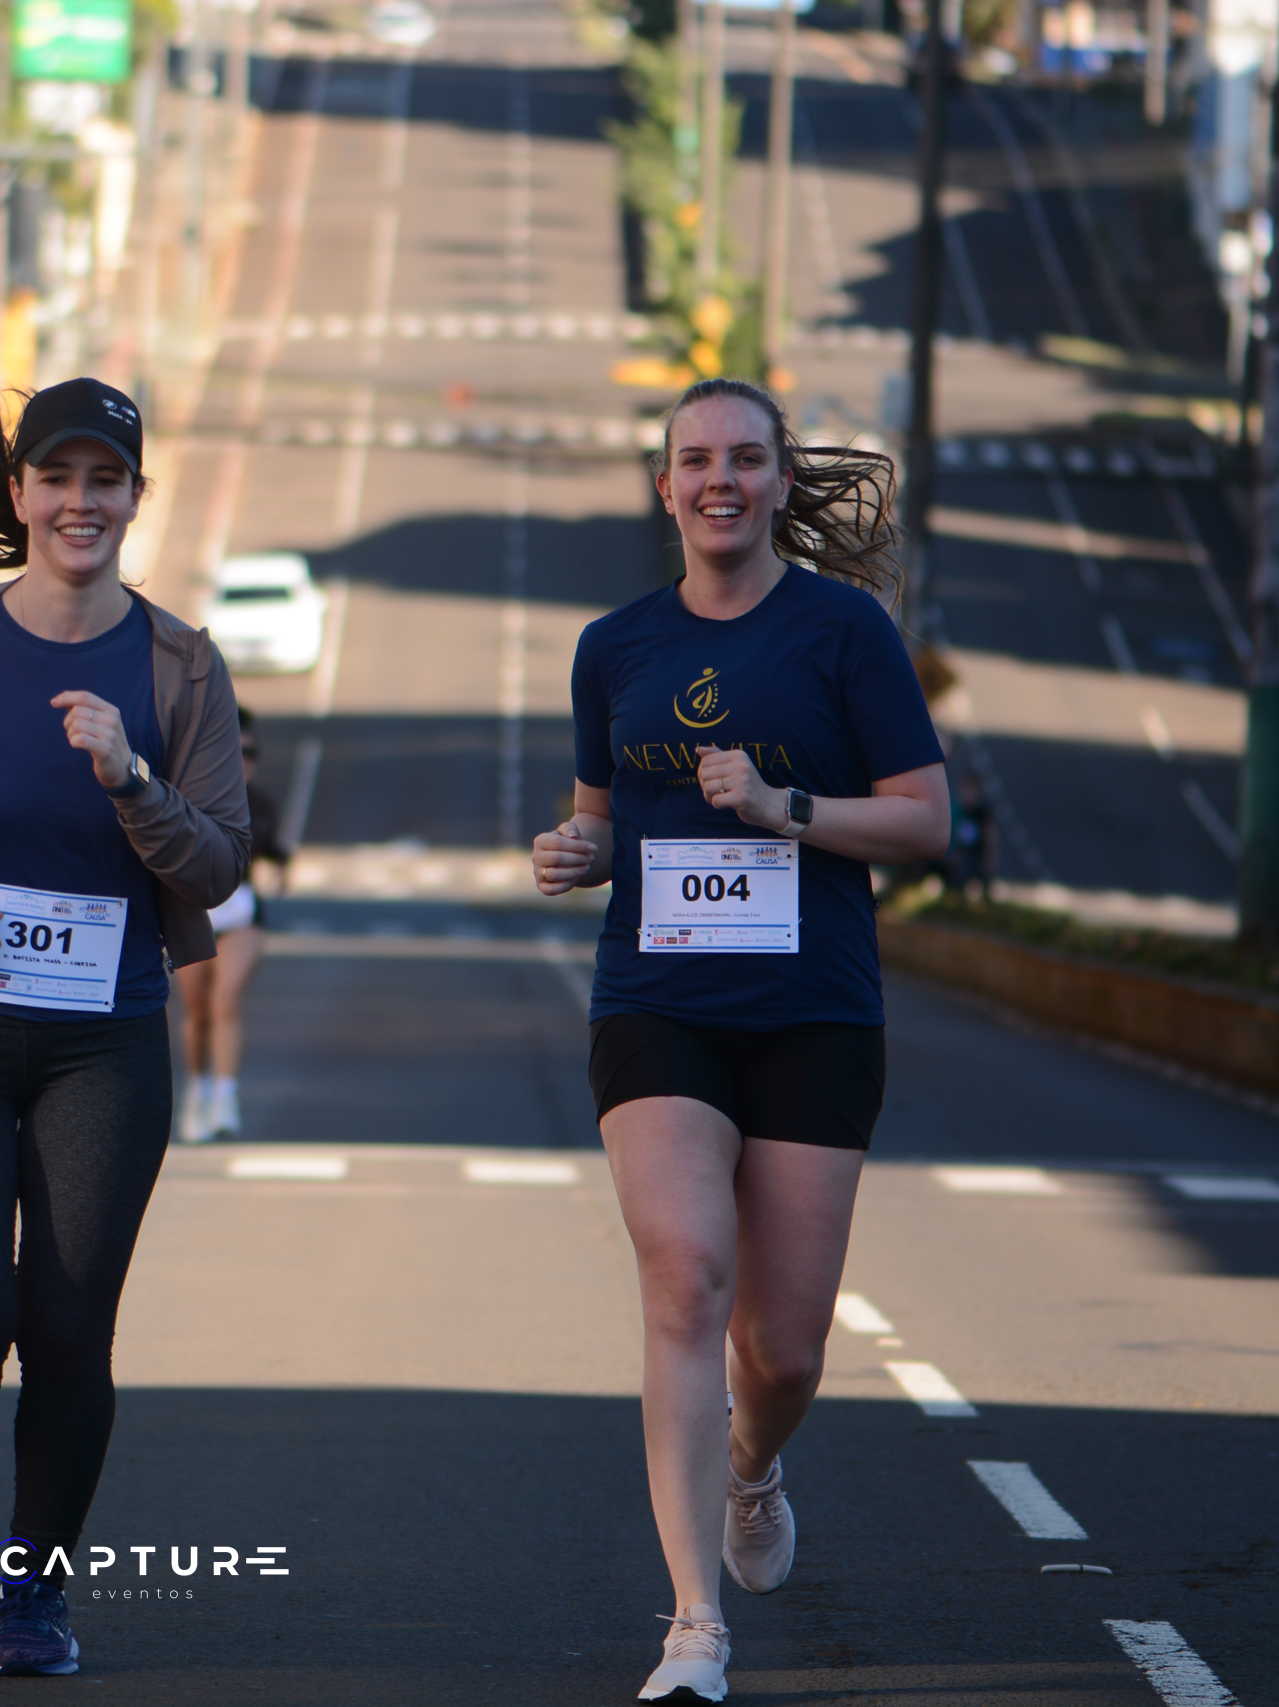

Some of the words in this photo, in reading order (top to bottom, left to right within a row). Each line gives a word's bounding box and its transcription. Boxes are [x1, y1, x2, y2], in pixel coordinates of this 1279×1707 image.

[623, 742, 700, 771] NEW
[682, 874, 751, 902] 004
[85, 913, 106, 921] CAUSA
[5, 920, 73, 955] 301
[12, 954, 40, 963] BATISTA
[69, 960, 98, 968] CORRIDA
